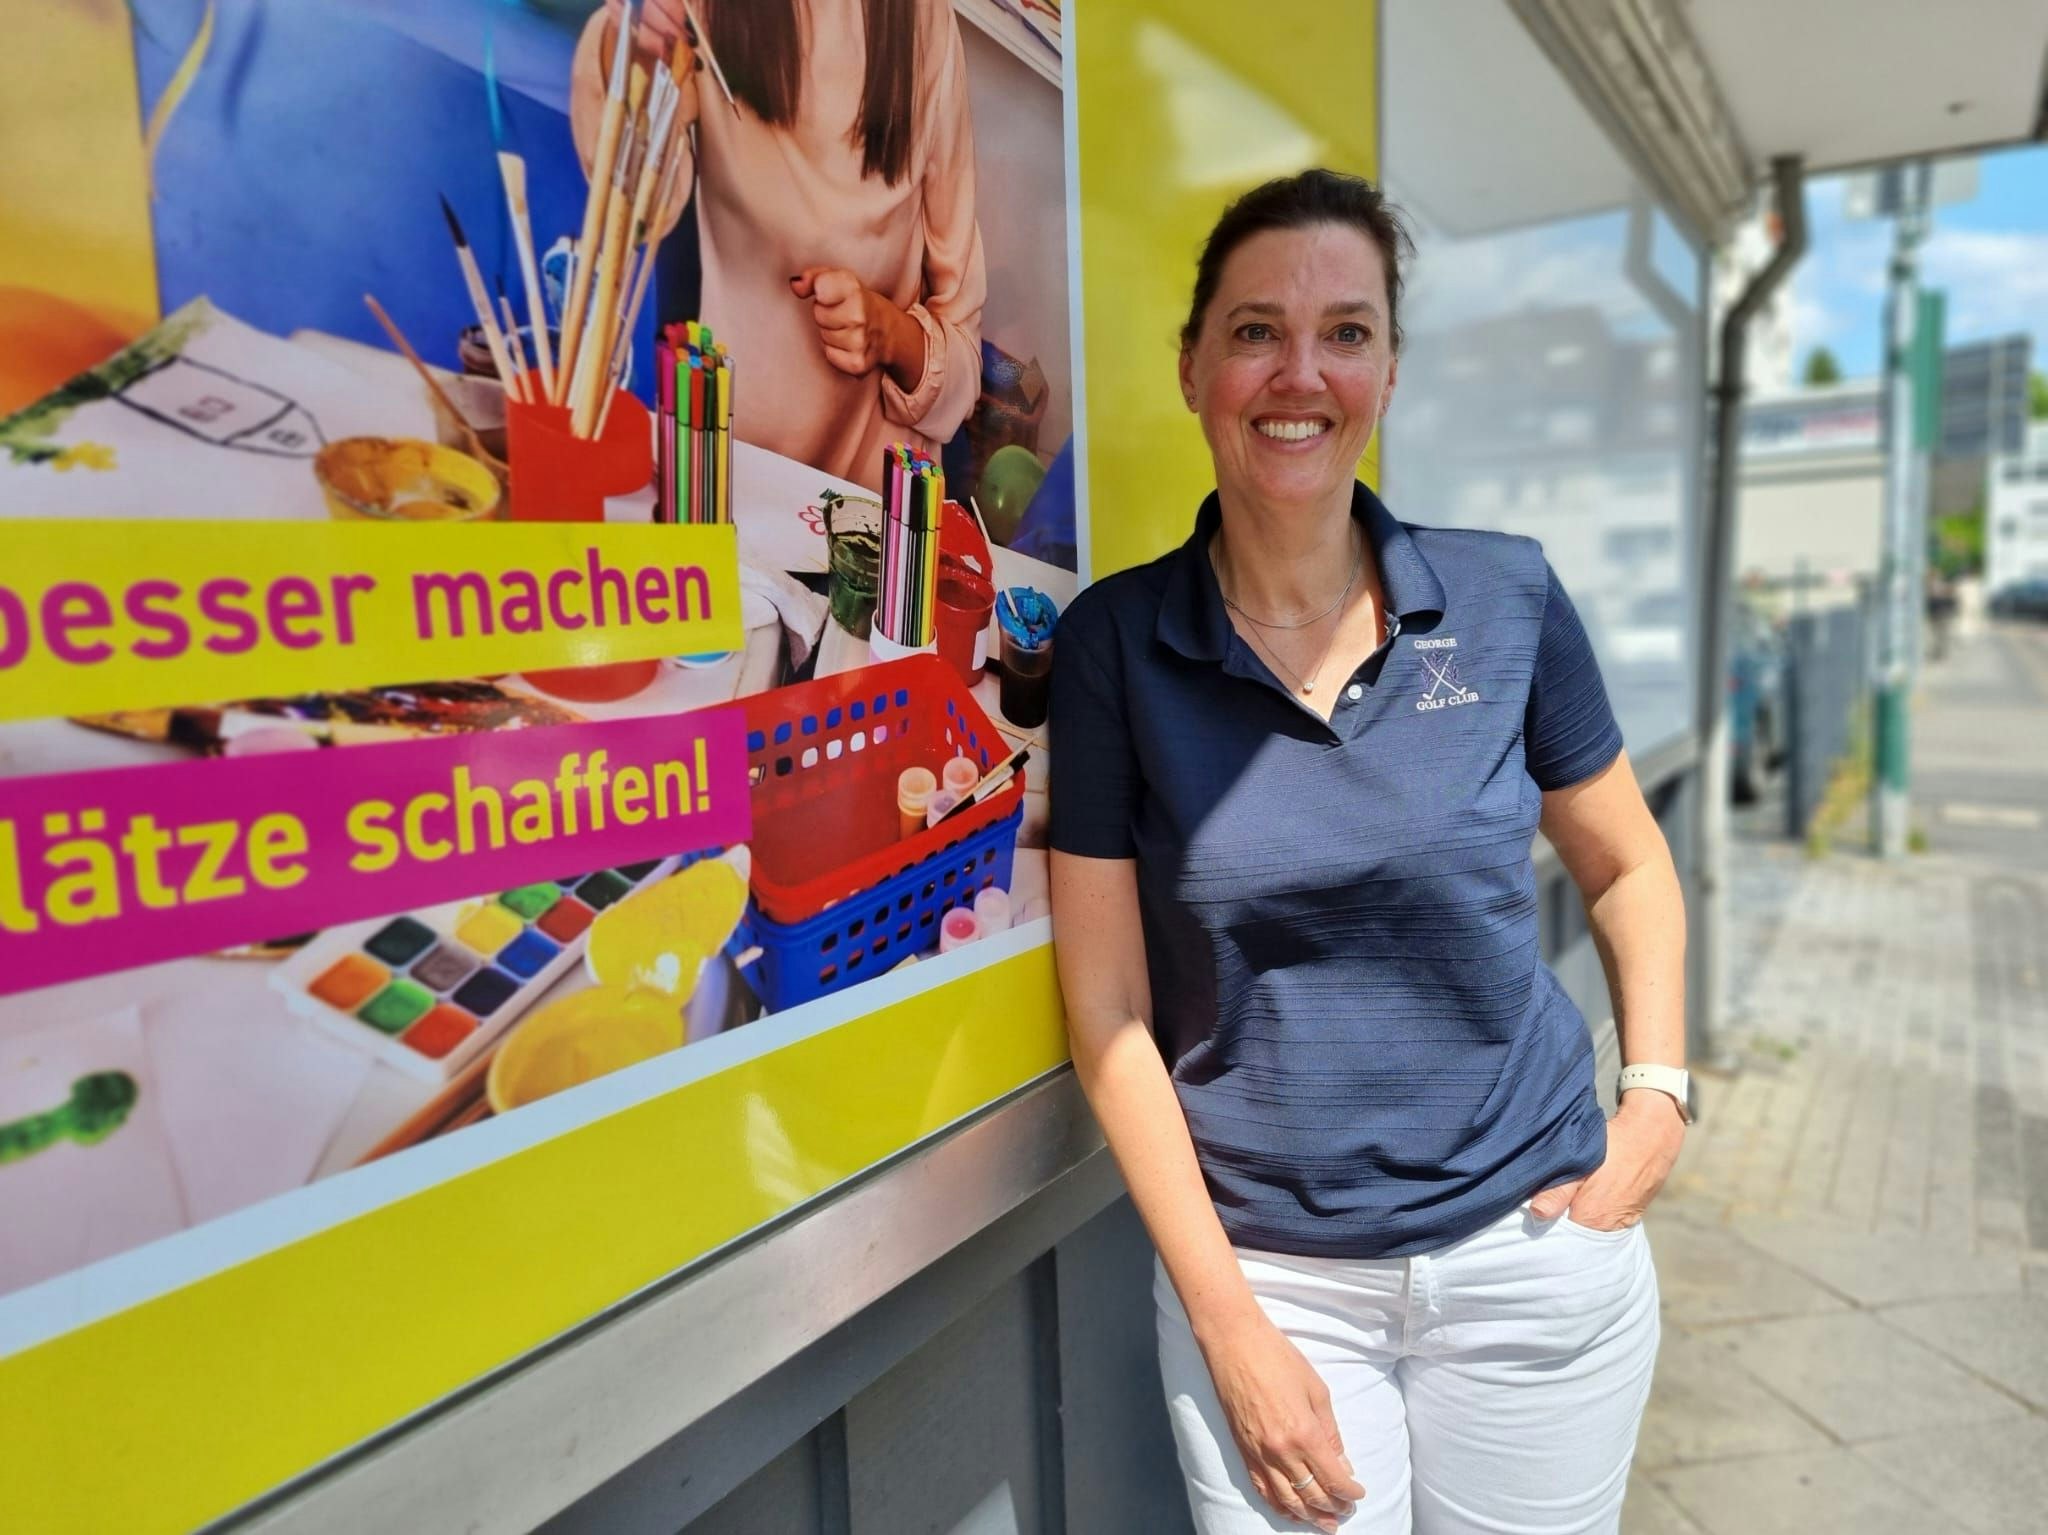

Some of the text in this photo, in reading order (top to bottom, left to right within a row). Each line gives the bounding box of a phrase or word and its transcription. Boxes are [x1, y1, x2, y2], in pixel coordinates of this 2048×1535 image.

[412, 547, 712, 641] machen
[1414, 638, 1458, 650] GEORGE
[1416, 692, 1480, 711] GOLF CLUB
[346, 737, 711, 872] schaffen!
